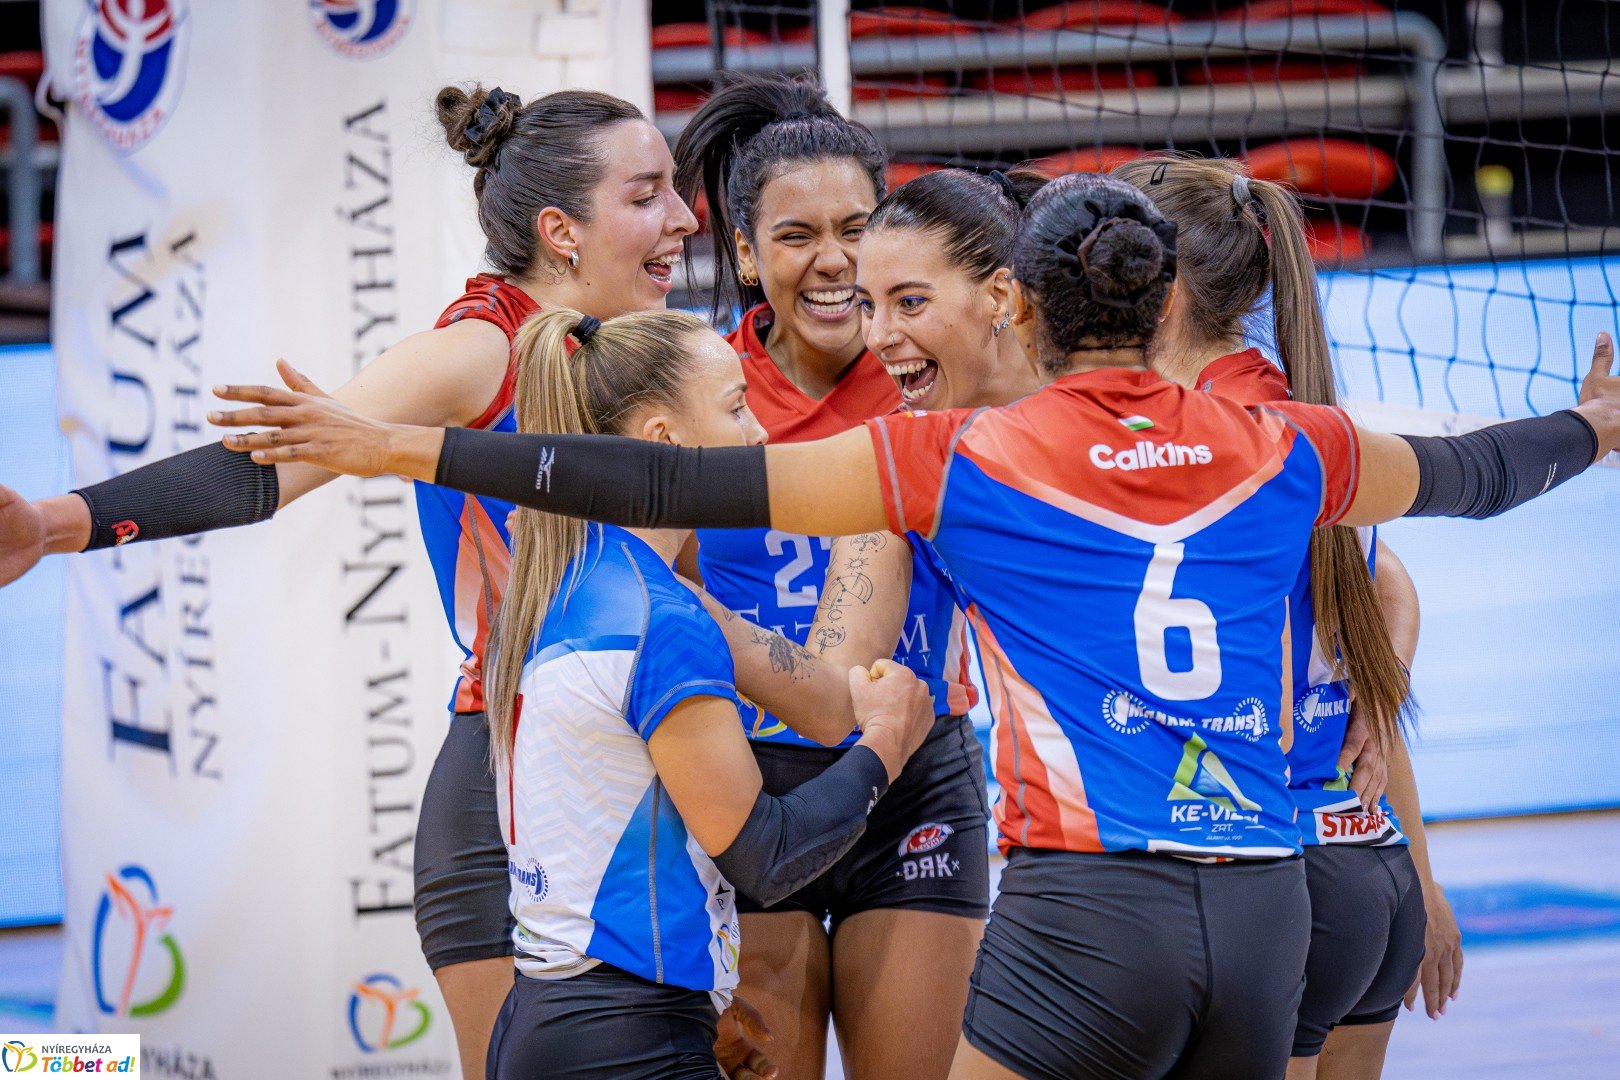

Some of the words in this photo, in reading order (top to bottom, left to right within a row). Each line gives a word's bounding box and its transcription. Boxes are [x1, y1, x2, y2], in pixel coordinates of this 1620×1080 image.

[100, 225, 177, 777] FAUM
[1089, 441, 1213, 471] Calkins
[1133, 542, 1222, 702] 6
[1202, 714, 1256, 732] TRANS
